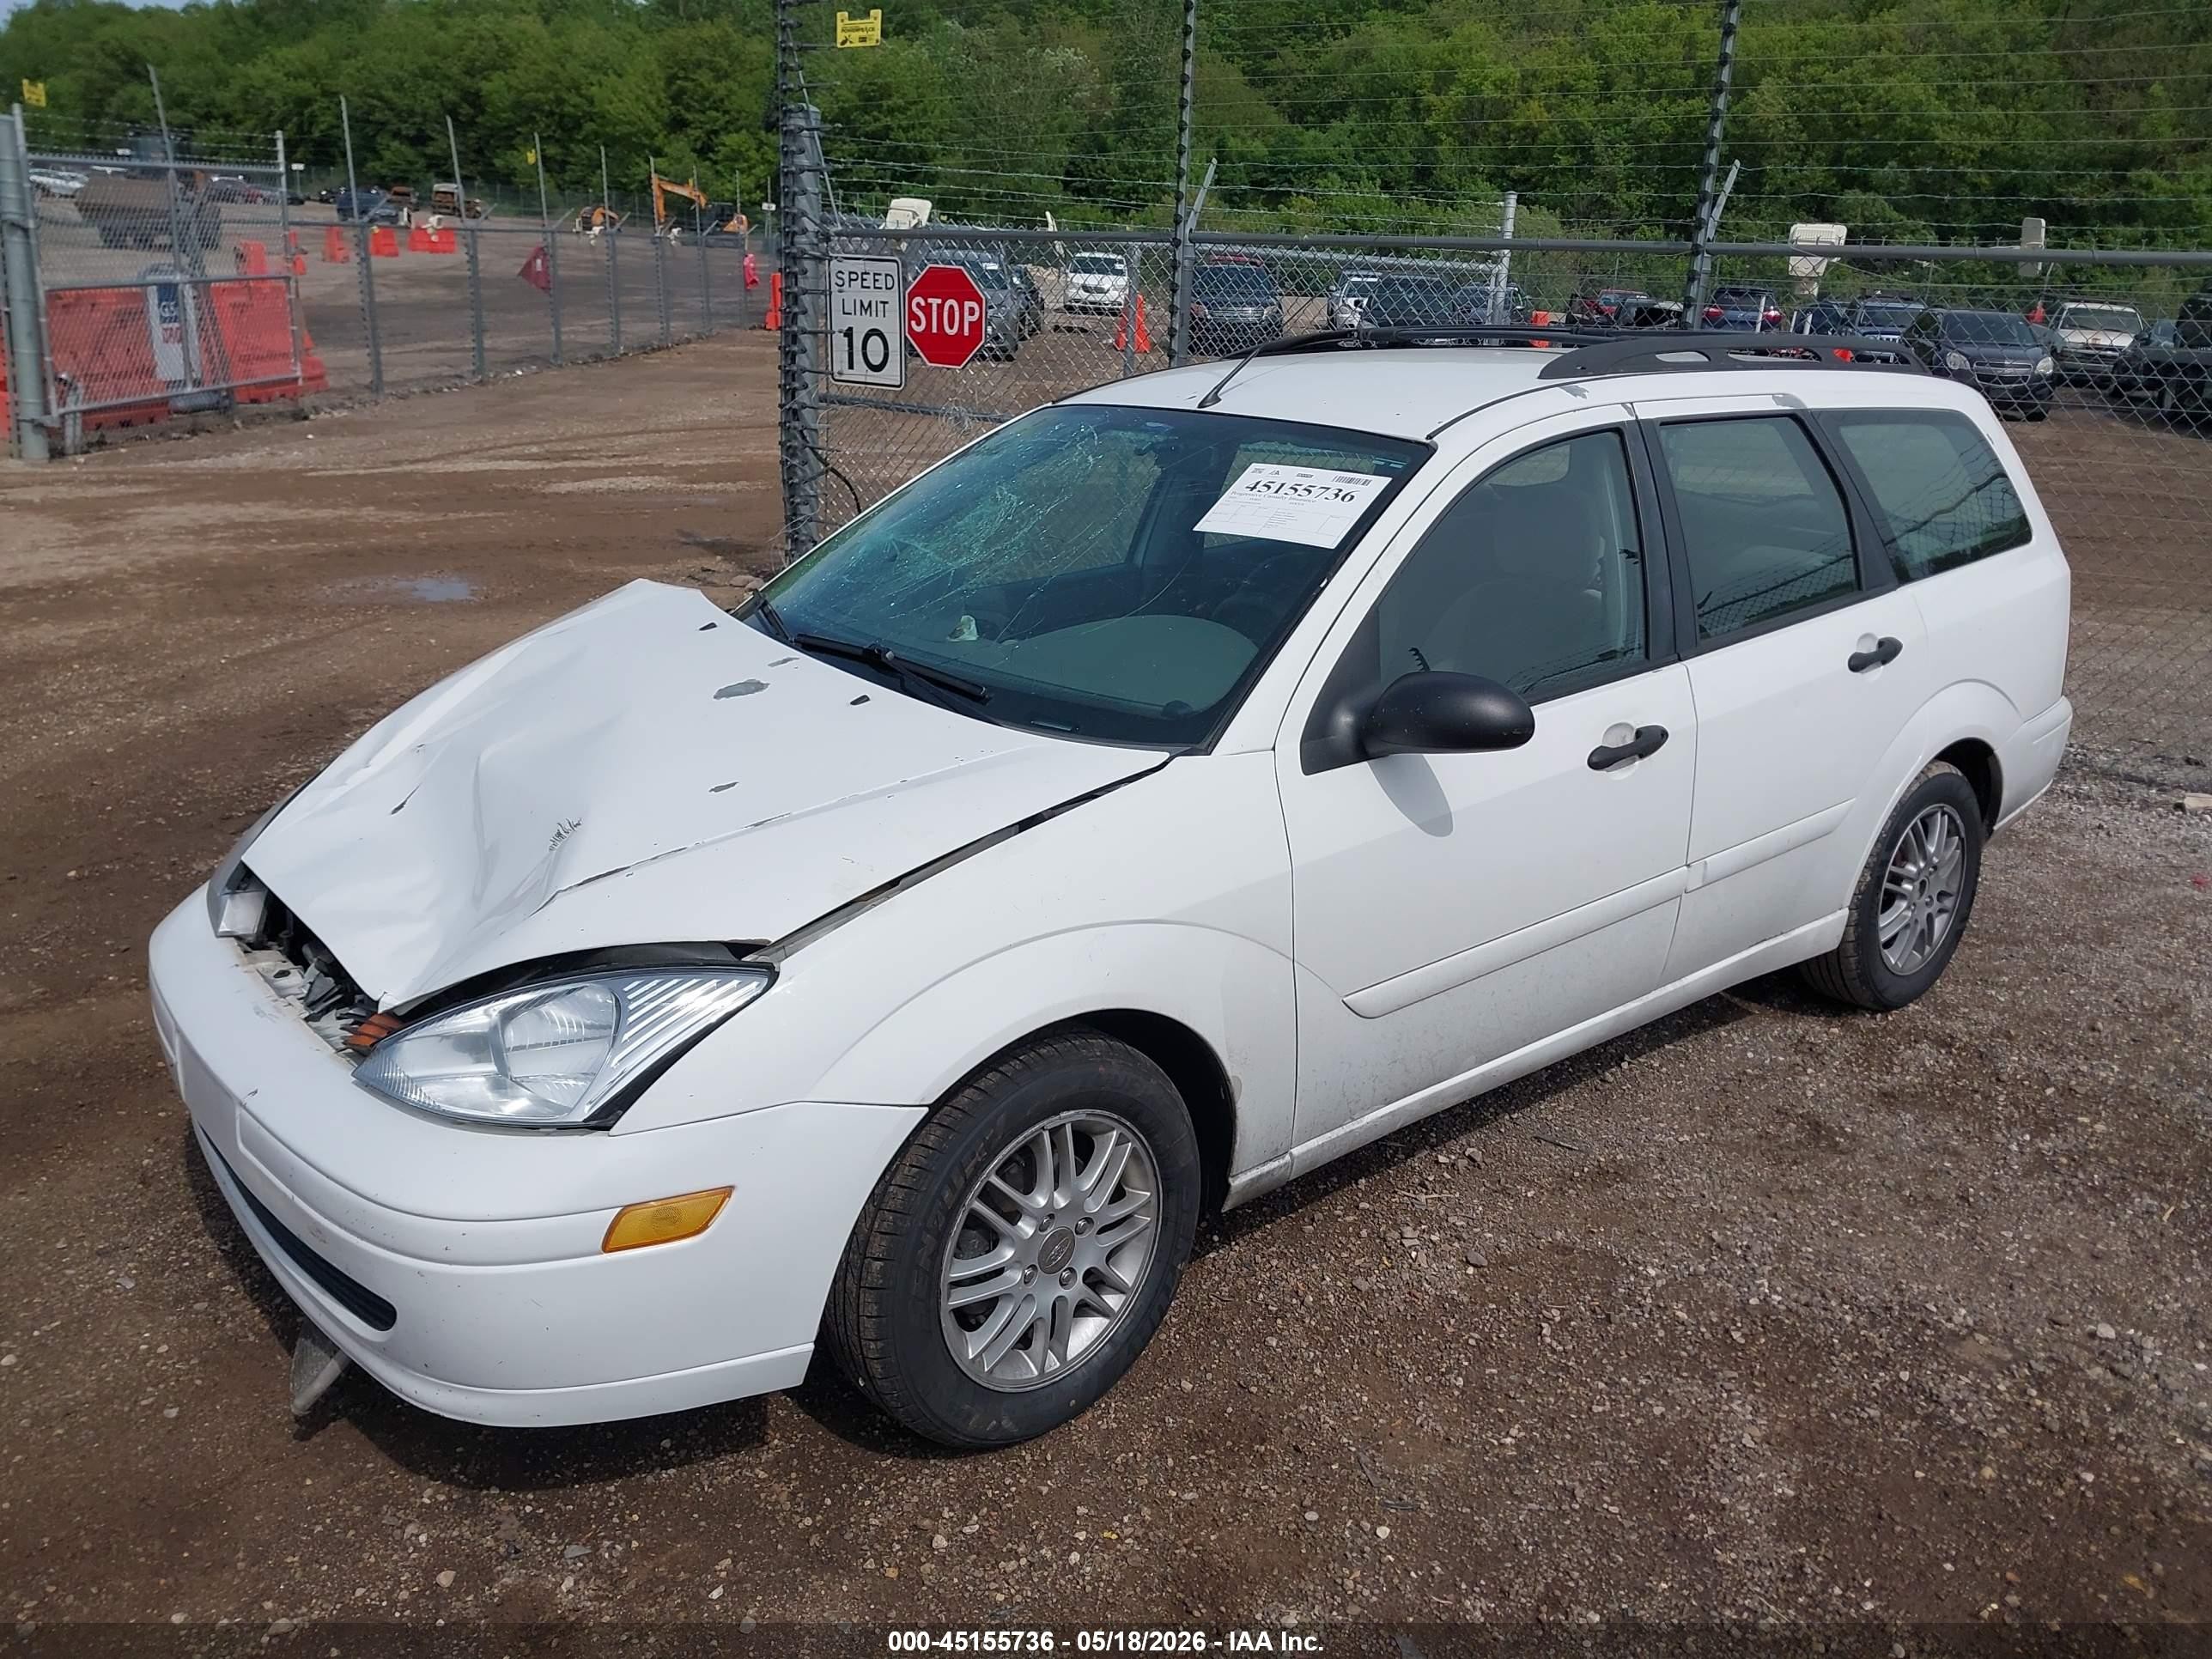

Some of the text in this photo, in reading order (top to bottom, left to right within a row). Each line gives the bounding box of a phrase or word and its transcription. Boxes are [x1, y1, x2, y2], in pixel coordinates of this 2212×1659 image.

[835, 270, 895, 290] SPEED
[842, 298, 889, 318] LIMIT
[910, 296, 980, 337] STOP
[843, 326, 890, 373] 10
[1245, 479, 1360, 503] 45155736
